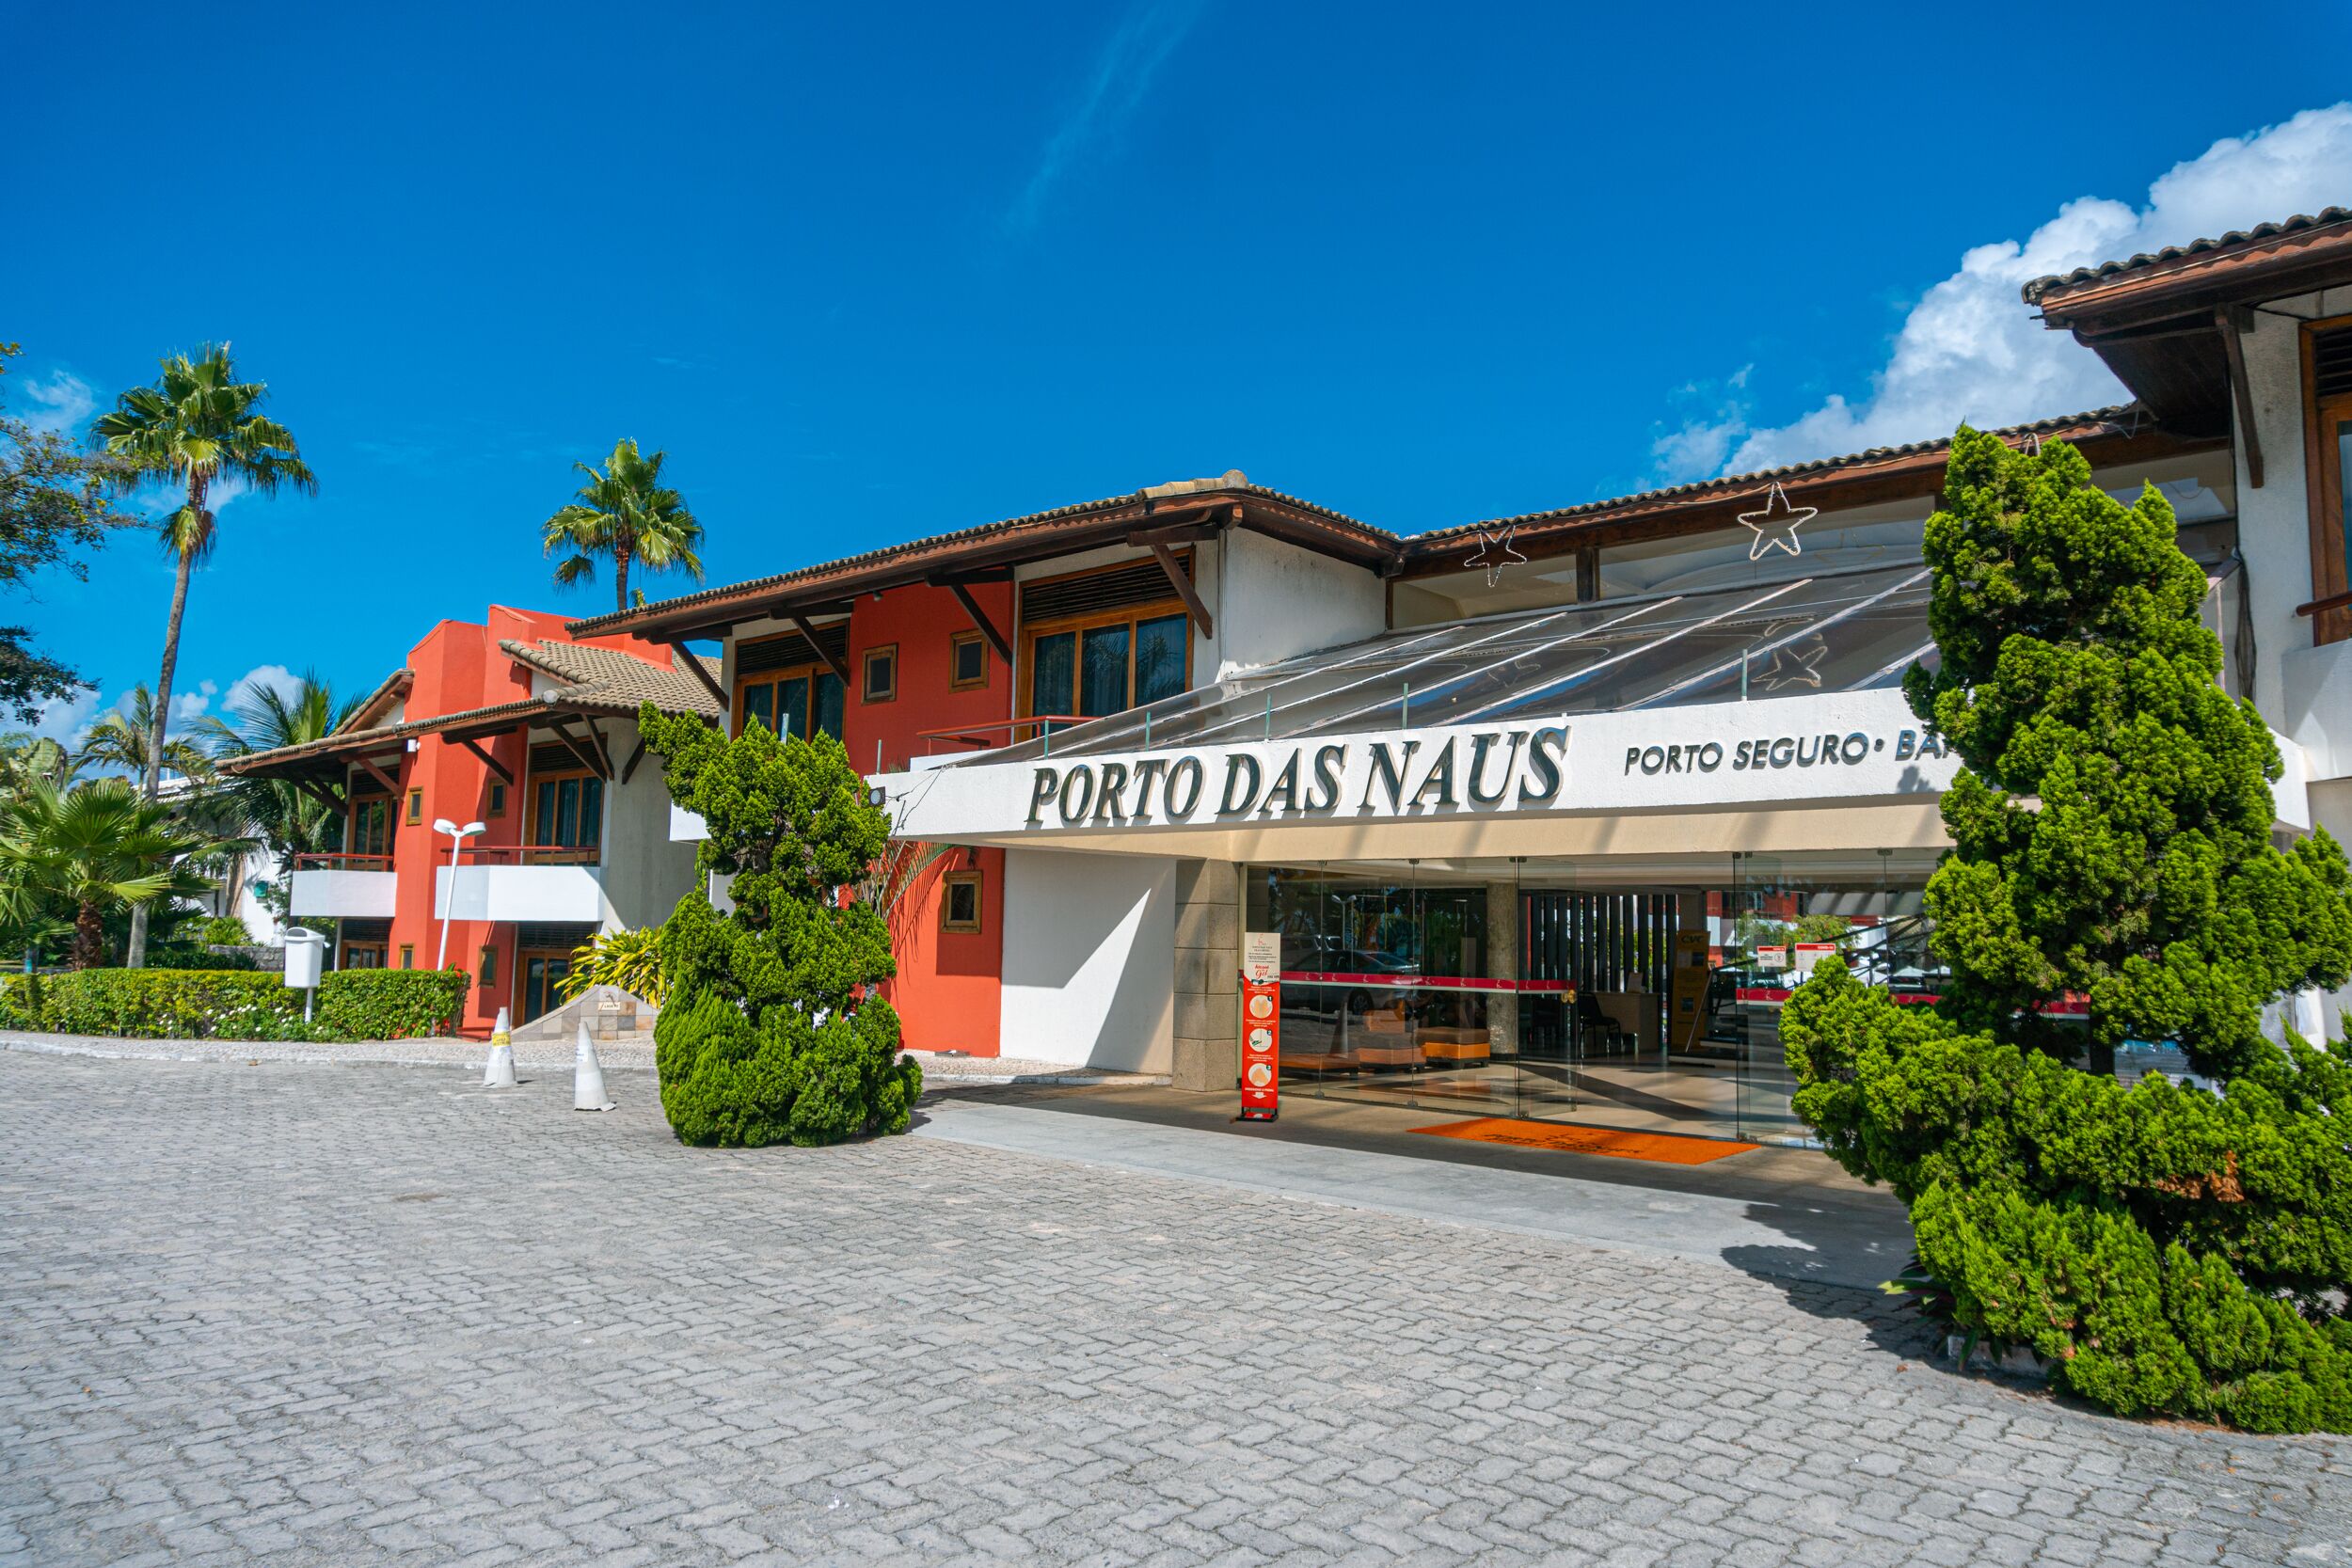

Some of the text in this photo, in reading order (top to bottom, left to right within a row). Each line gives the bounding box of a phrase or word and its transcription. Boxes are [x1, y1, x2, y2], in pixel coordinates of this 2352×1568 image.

[1024, 725, 1572, 823] PORTO DAS NAUS
[1625, 742, 1723, 775] PORTO
[1895, 729, 1949, 761] BA
